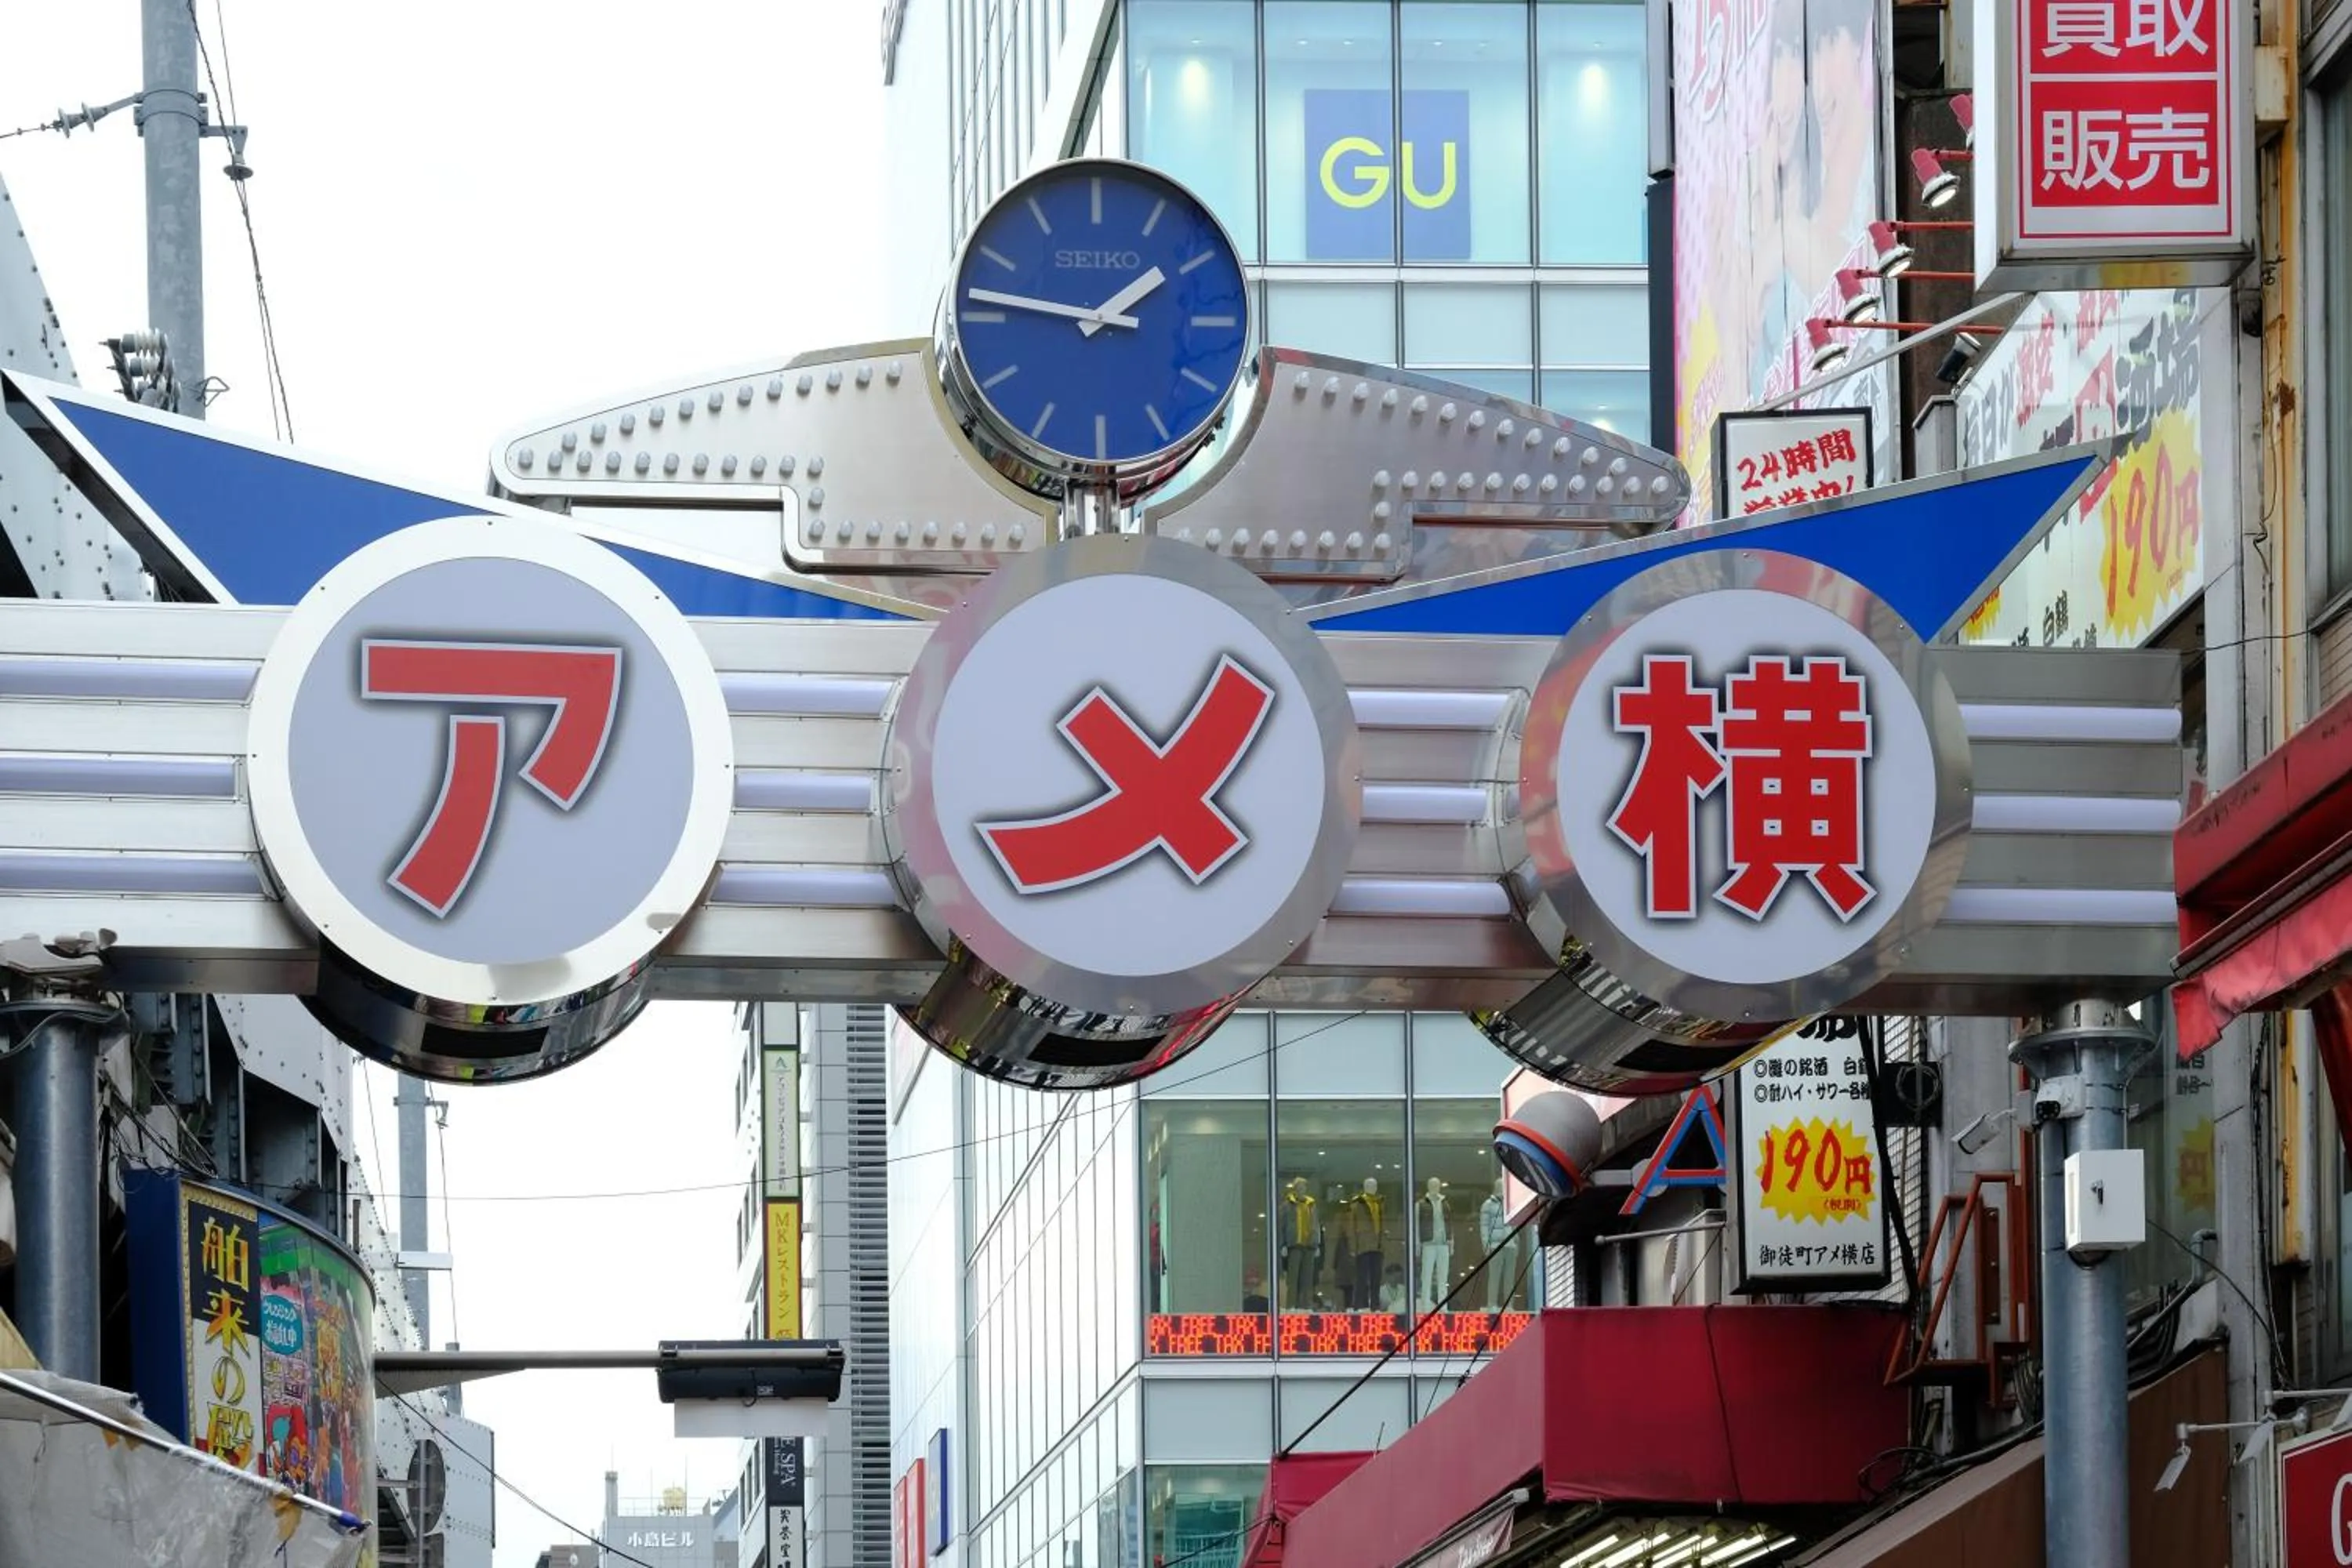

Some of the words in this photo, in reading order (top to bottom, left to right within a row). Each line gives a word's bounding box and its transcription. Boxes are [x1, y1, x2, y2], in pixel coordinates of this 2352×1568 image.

[2041, 107, 2210, 191] 販売
[1319, 136, 1457, 209] GU
[1055, 250, 1141, 269] SEIKO
[1737, 428, 1857, 491] 24時間
[2106, 444, 2200, 618] 190円
[1761, 1127, 1871, 1194] 190円
[1759, 1242, 1875, 1267] 御徒町アメ横店
[1151, 1316, 1171, 1334] AX
[1181, 1316, 1214, 1334] FREE
[1226, 1316, 1258, 1334] TAX
[1320, 1315, 1351, 1334] TAX
[1361, 1315, 1395, 1334] FREE
[1454, 1314, 1488, 1333] FREE
[1169, 1334, 1203, 1354] FREE
[1215, 1334, 1244, 1354] TAX
[1308, 1334, 1338, 1354] TAX
[1348, 1334, 1381, 1353] FREE
[1443, 1333, 1475, 1353] FREE
[627, 1531, 694, 1547] 小島ビル
